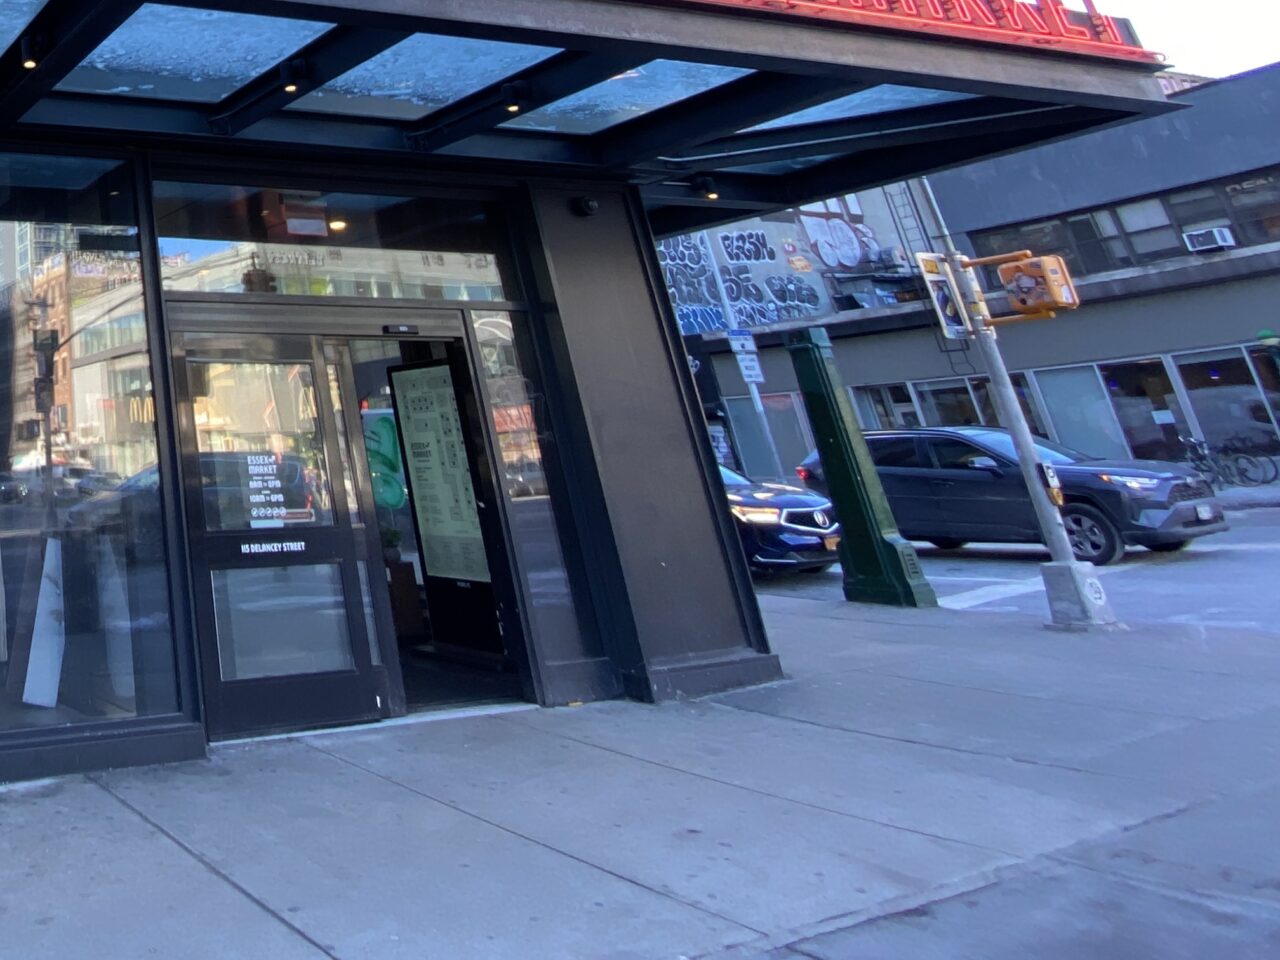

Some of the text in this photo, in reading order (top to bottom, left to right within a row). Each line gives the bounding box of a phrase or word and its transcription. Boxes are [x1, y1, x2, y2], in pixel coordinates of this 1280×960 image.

[247, 455, 269, 465] ESSEX
[248, 465, 277, 474] MARKET
[250, 542, 282, 553] DELANCEY
[283, 542, 305, 551] STREET
